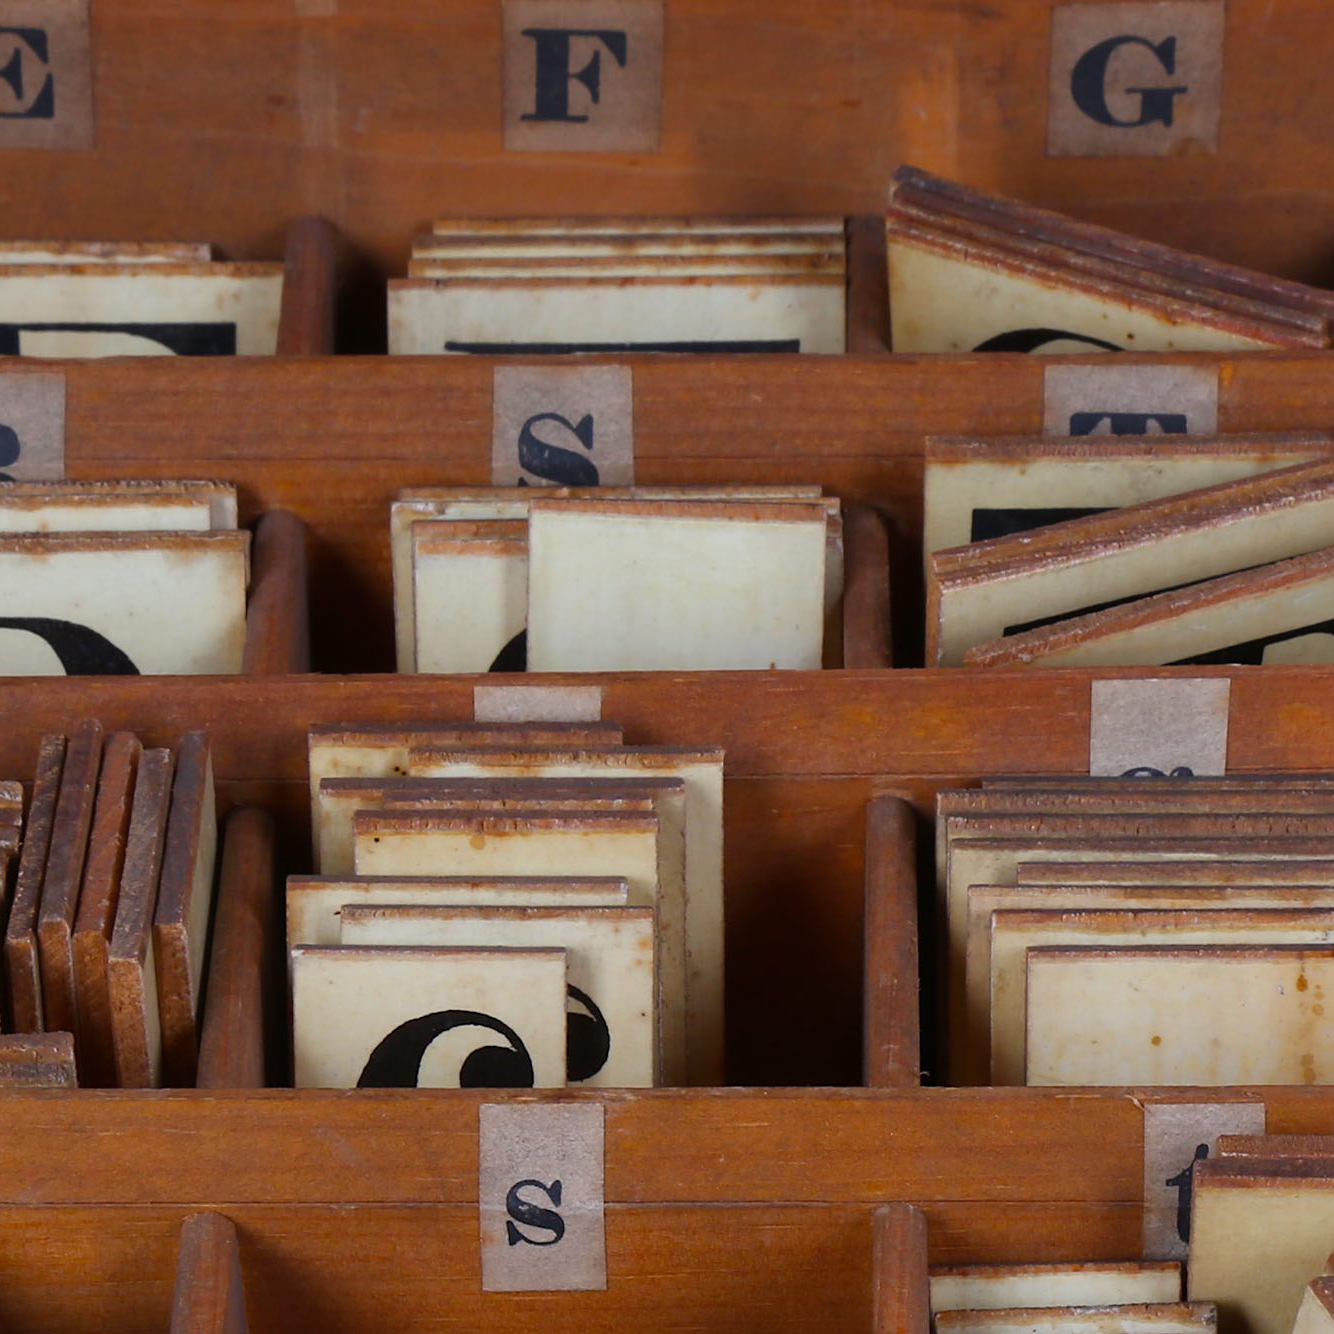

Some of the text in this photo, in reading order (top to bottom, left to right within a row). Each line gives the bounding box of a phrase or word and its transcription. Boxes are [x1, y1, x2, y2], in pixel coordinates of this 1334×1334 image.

[521, 29, 627, 123] F
[1071, 35, 1188, 128] G
[518, 413, 600, 487] S
[506, 1180, 565, 1246] s
